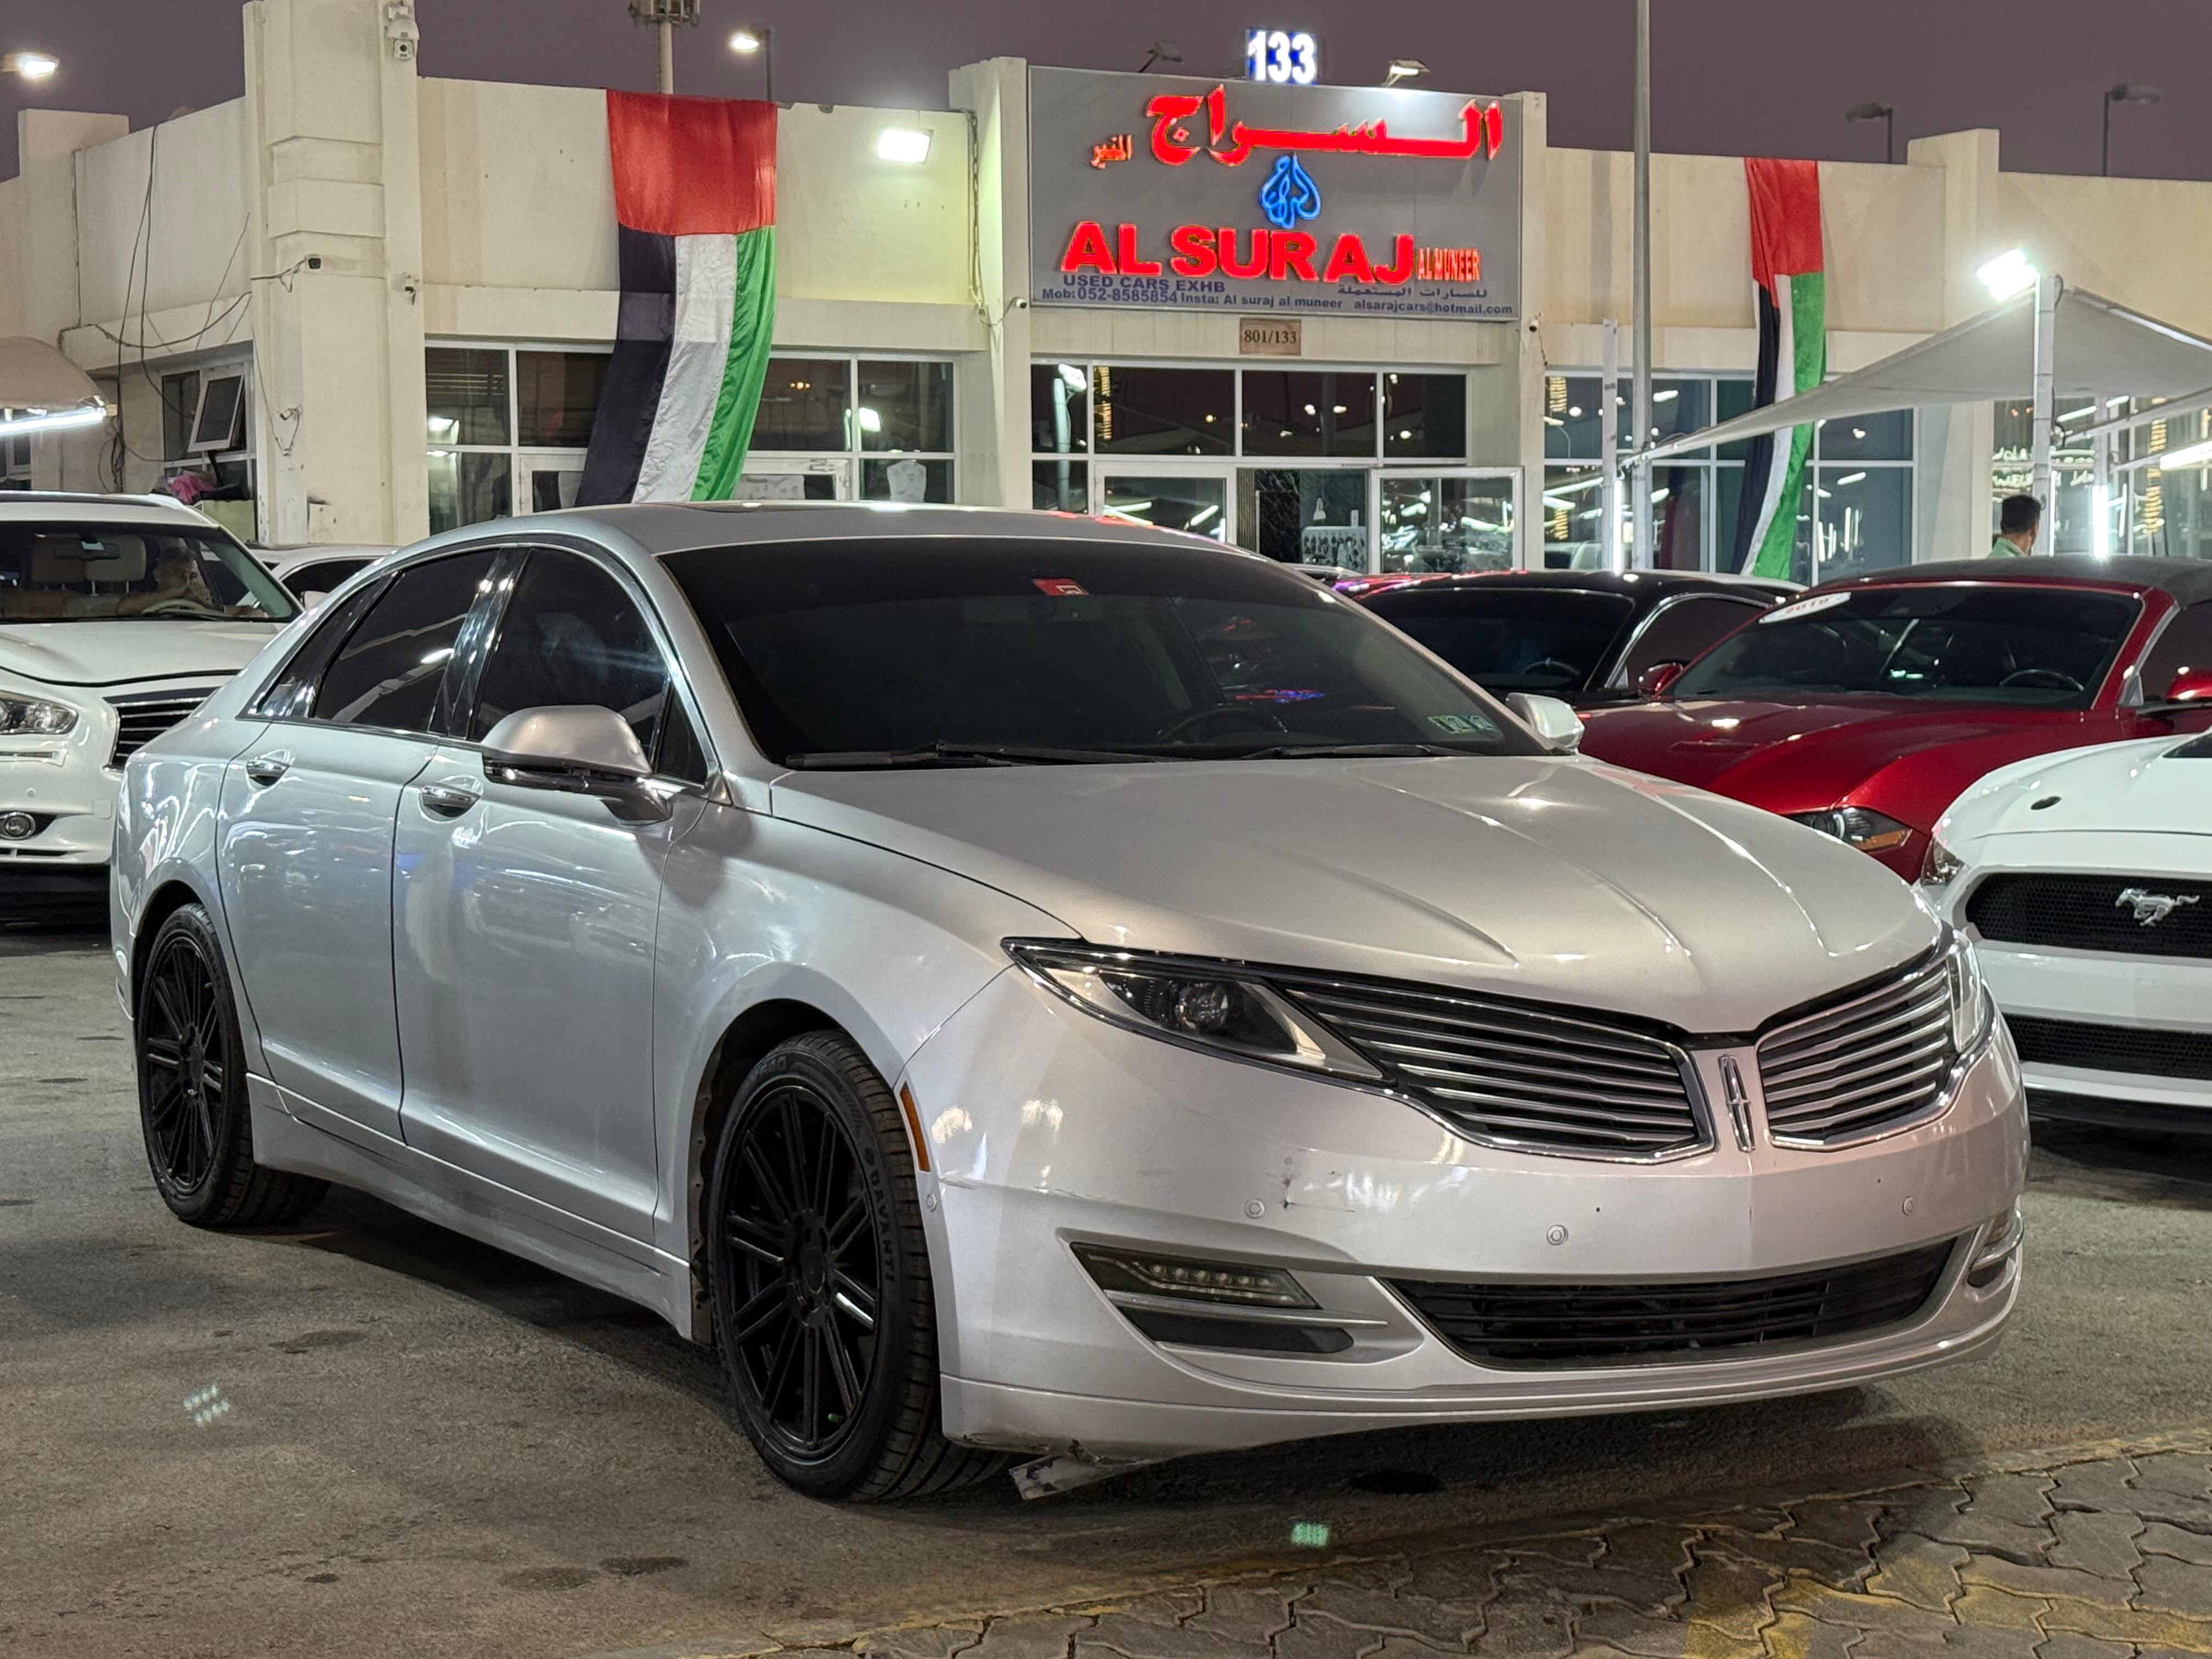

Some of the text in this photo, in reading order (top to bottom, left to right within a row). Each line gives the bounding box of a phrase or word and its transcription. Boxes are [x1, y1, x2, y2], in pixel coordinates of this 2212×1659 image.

[1248, 31, 1316, 84] 133
[1146, 83, 1503, 166] السراج
[1060, 221, 1163, 276] AL
[1171, 224, 1414, 285] SURAJ
[1063, 274, 1225, 292] USED CARS EXHB
[1181, 293, 1219, 304] Insta:
[1223, 294, 1237, 305] Al
[1241, 295, 1274, 308] suraj
[1279, 296, 1291, 307] al
[1294, 297, 1343, 308] muneer
[1244, 329, 1297, 344] 801/133
[870, 1168, 895, 1283] DAVANTI
